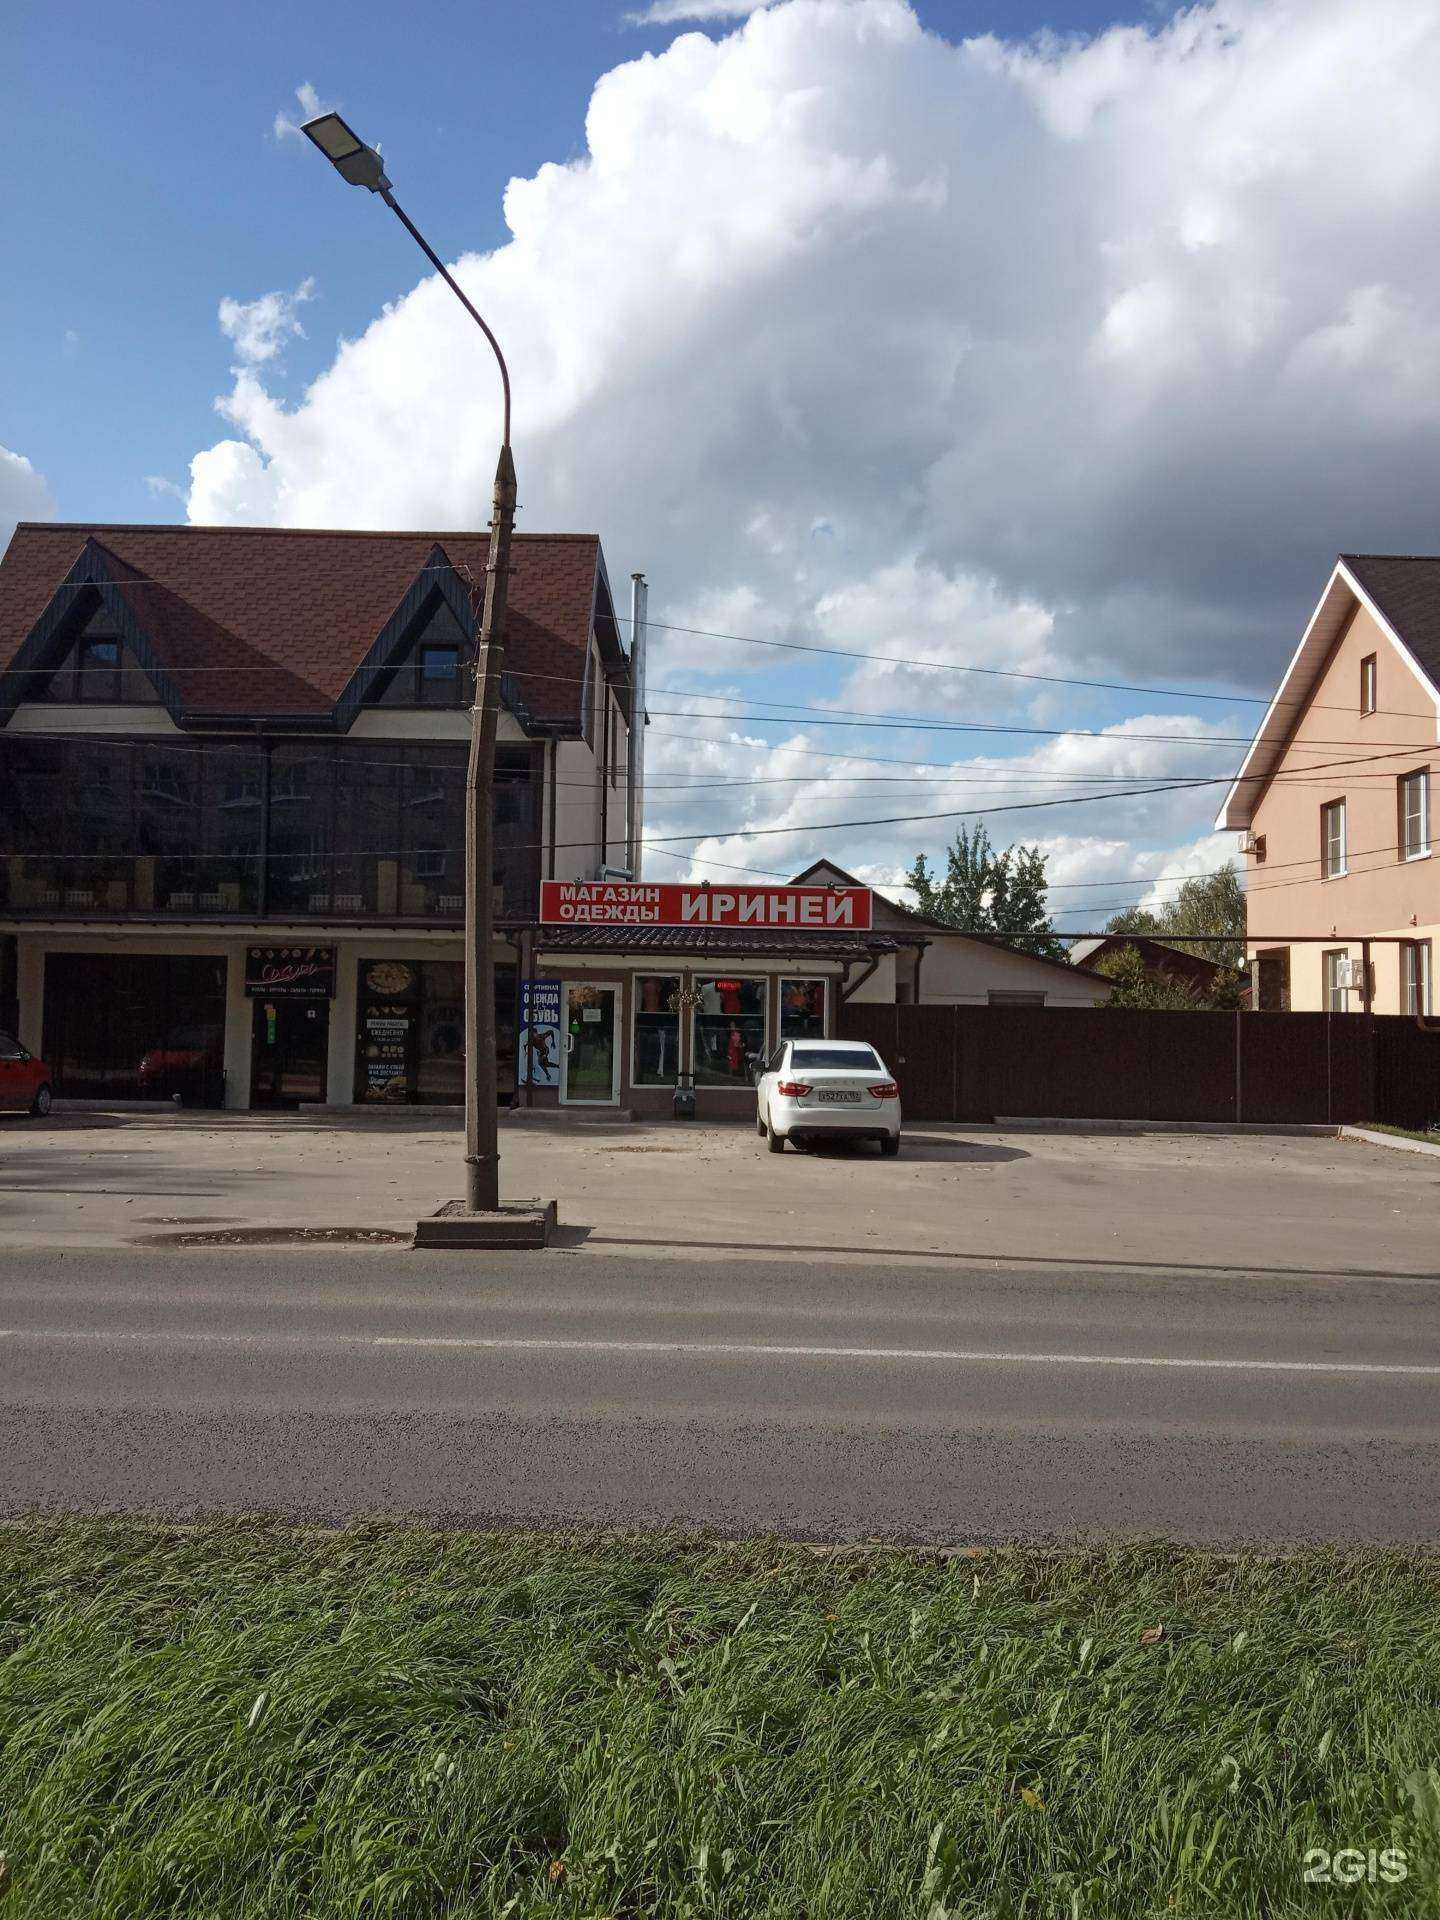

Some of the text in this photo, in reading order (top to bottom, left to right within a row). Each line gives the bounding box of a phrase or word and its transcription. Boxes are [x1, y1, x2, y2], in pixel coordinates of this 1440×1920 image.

[559, 886, 660, 903] МАГАЗИН
[559, 903, 660, 923] ОДЕЖДЫ
[681, 889, 853, 924] ИРИНЕЙ
